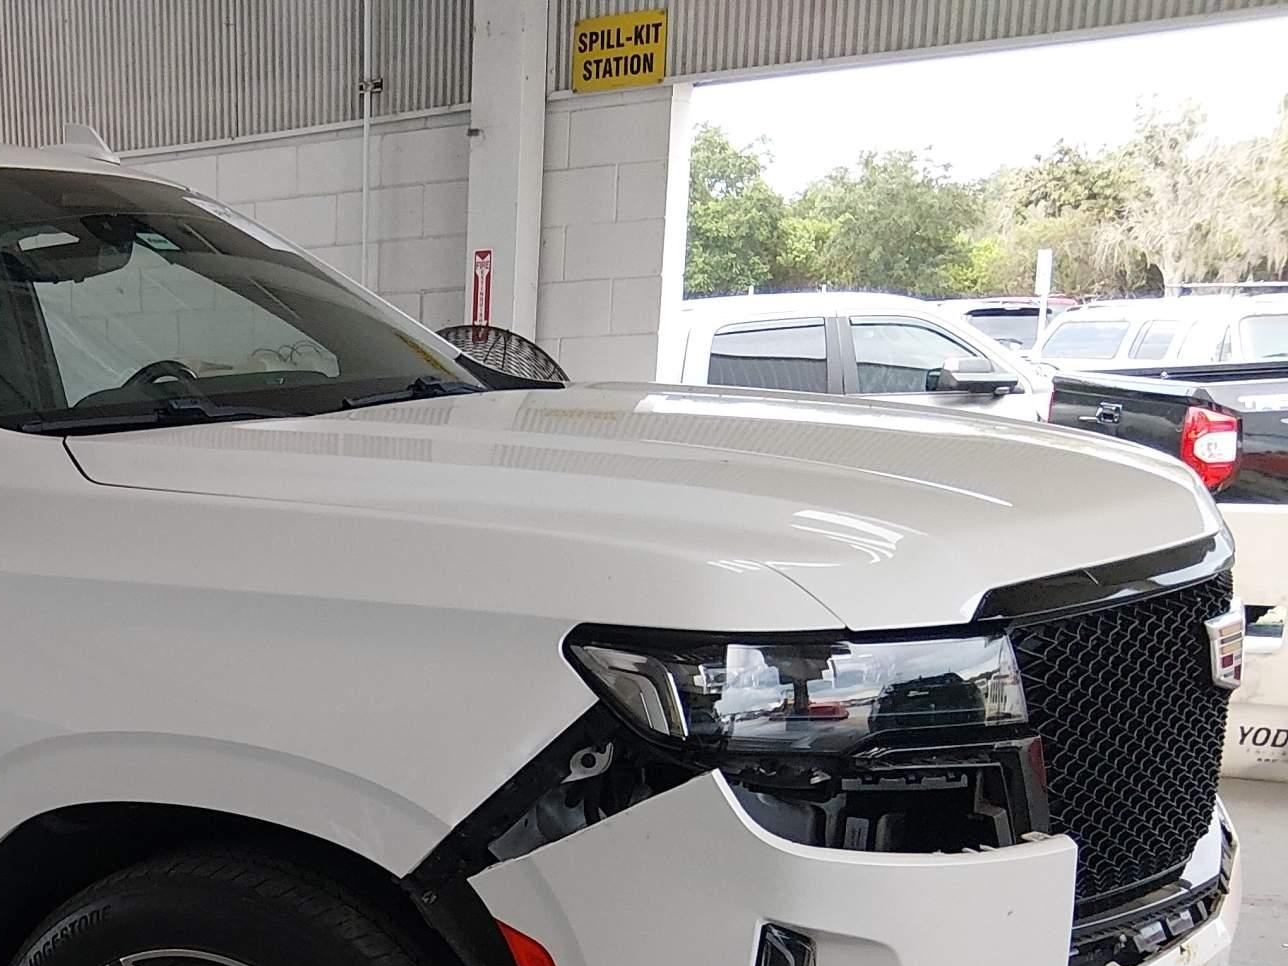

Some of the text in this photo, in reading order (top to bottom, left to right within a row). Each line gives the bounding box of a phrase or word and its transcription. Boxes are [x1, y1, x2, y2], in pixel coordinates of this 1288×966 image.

[577, 22, 663, 54] SPILL-KIT
[582, 52, 654, 81] STATION
[476, 261, 490, 270] FIRE
